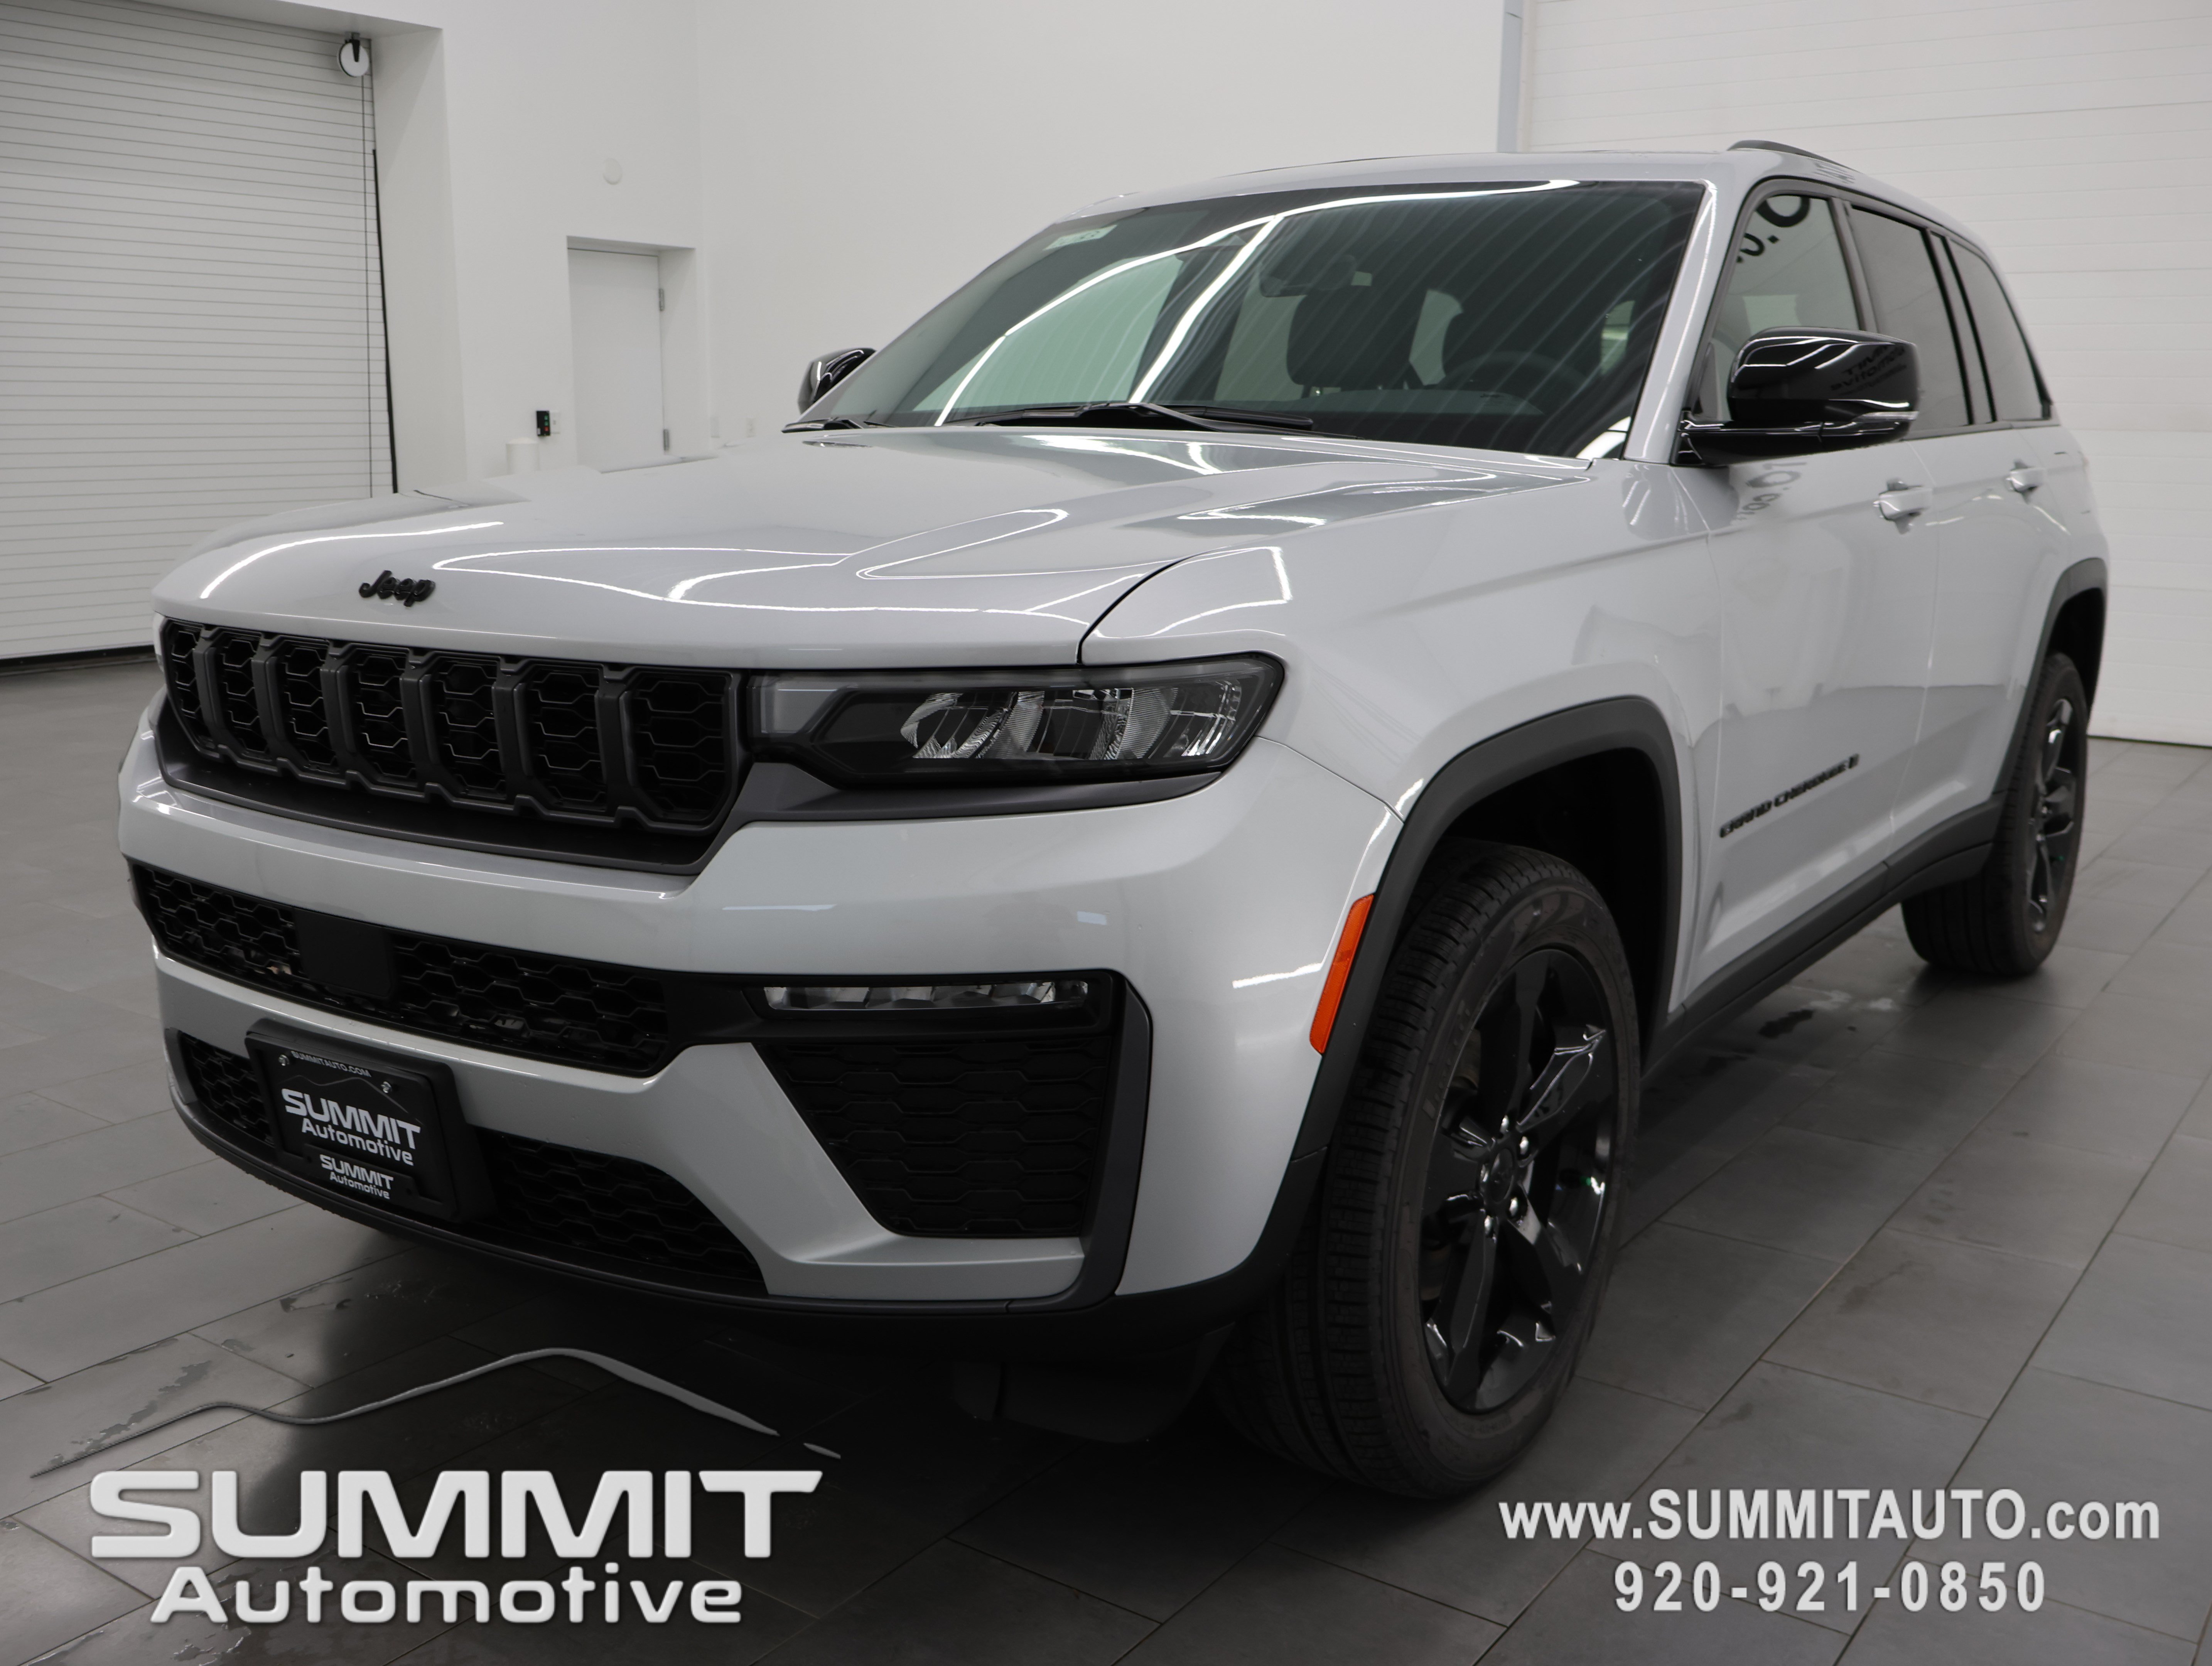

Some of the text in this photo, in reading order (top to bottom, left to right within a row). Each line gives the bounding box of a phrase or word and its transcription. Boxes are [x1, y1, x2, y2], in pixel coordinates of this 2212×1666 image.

[359, 570, 436, 607] Jeep
[290, 1050, 372, 1078] SUMMITAUTO.COM
[282, 1088, 421, 1149] SUMMIT
[302, 1118, 414, 1166] Automotive
[320, 1154, 394, 1190] SUMMIT
[330, 1172, 390, 1200] Automotive
